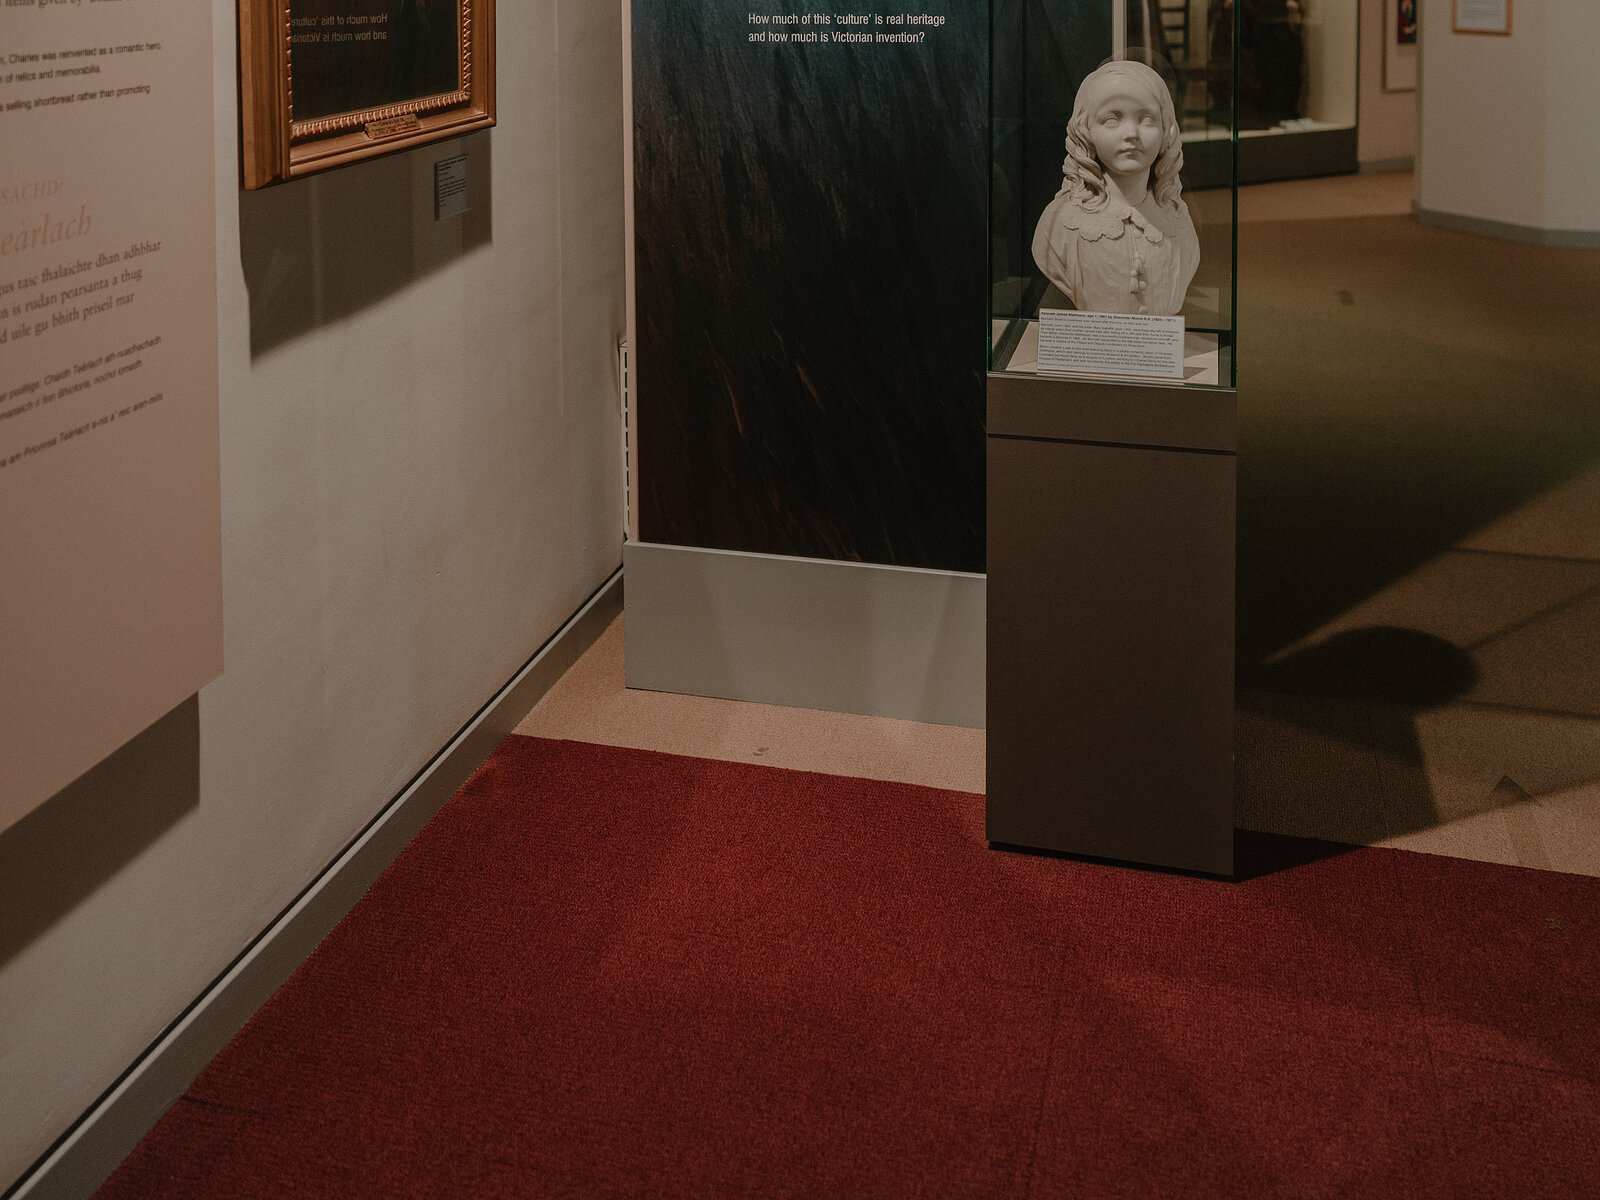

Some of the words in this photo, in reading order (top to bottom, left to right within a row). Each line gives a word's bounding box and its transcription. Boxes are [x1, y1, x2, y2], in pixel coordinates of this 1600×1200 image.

[749, 14, 769, 25] How
[772, 14, 798, 25] much
[801, 14, 811, 24] of
[814, 14, 830, 24] this
[875, 14, 883, 24] is
[886, 14, 903, 24] real
[907, 14, 945, 27] heritage
[749, 32, 766, 42] and
[768, 32, 788, 42] how
[791, 32, 817, 42] much
[820, 32, 829, 42] is
[831, 32, 872, 43] Victorian
[876, 32, 925, 43] invention?
[121, 268, 143, 283] thug
[116, 293, 135, 306] mar
